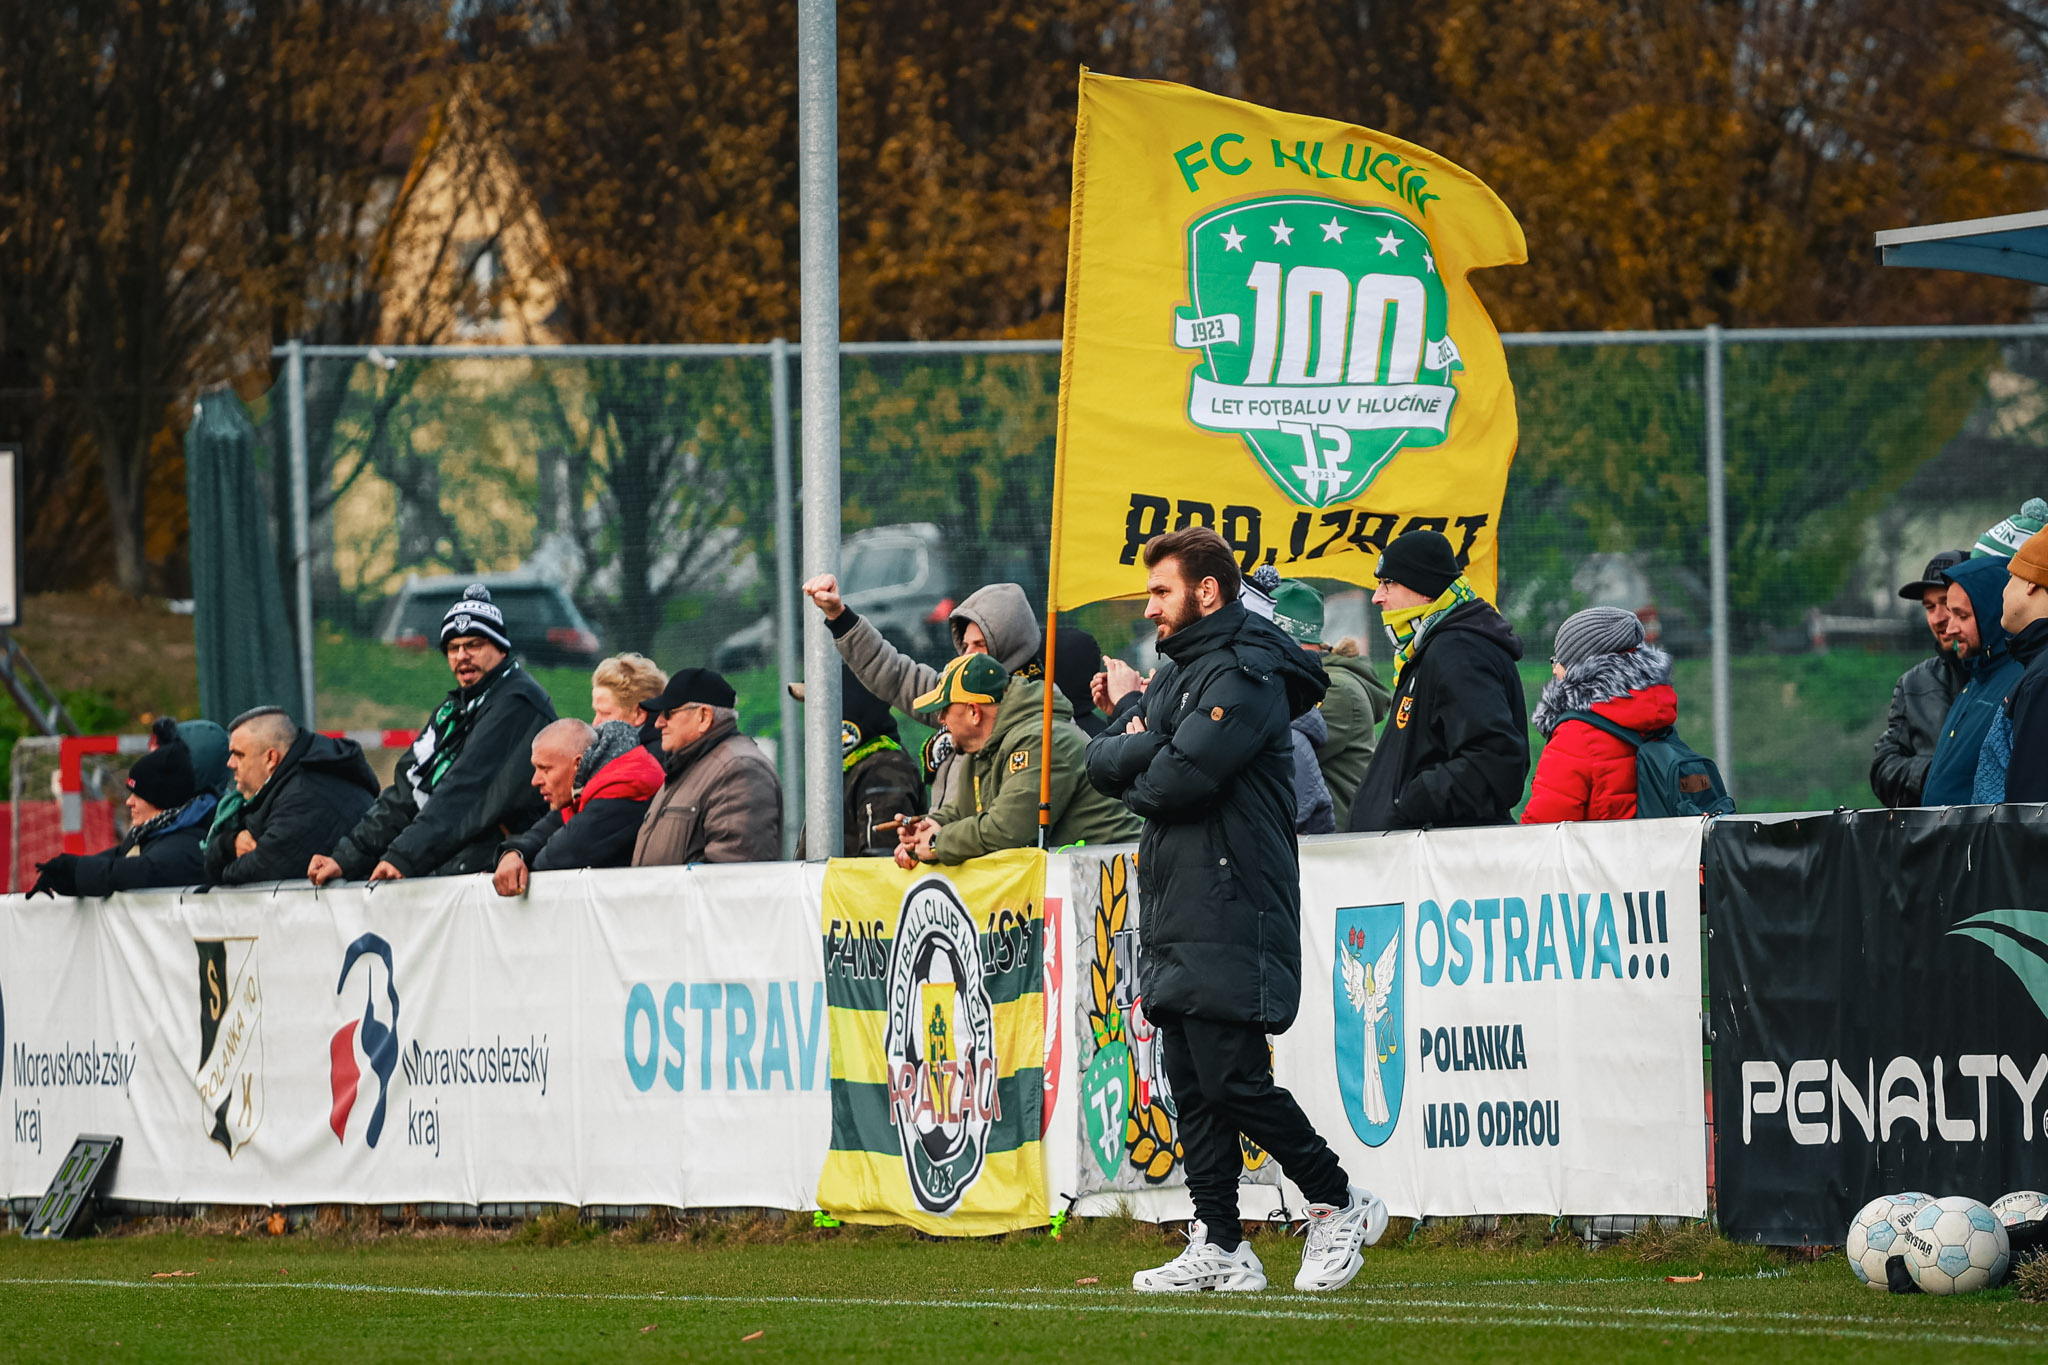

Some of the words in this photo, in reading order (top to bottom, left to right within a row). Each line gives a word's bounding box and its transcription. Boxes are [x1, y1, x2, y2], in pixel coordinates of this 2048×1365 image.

[1173, 132, 1253, 193] FC
[1191, 320, 1226, 343] 1923
[1242, 260, 1428, 384] 100
[1211, 397, 1244, 415] LET
[1248, 397, 1332, 416] FOTBALU
[1337, 397, 1352, 415] V
[1311, 470, 1336, 479] 1923
[827, 918, 888, 981] FANS
[1415, 889, 1670, 987] OSTRAVA!!!
[892, 907, 926, 1057] FOOTBALL
[924, 899, 959, 940] CLUB
[623, 980, 831, 1093] OSTRAV
[1420, 1024, 1528, 1073] POLANKA
[15, 1098, 42, 1155] kraj
[407, 1097, 440, 1158] kraj
[1423, 1101, 1470, 1150] NAD
[1477, 1099, 1560, 1148] ODROU
[1741, 1053, 2048, 1145] PENALTY
[926, 1164, 954, 1194] 1923
